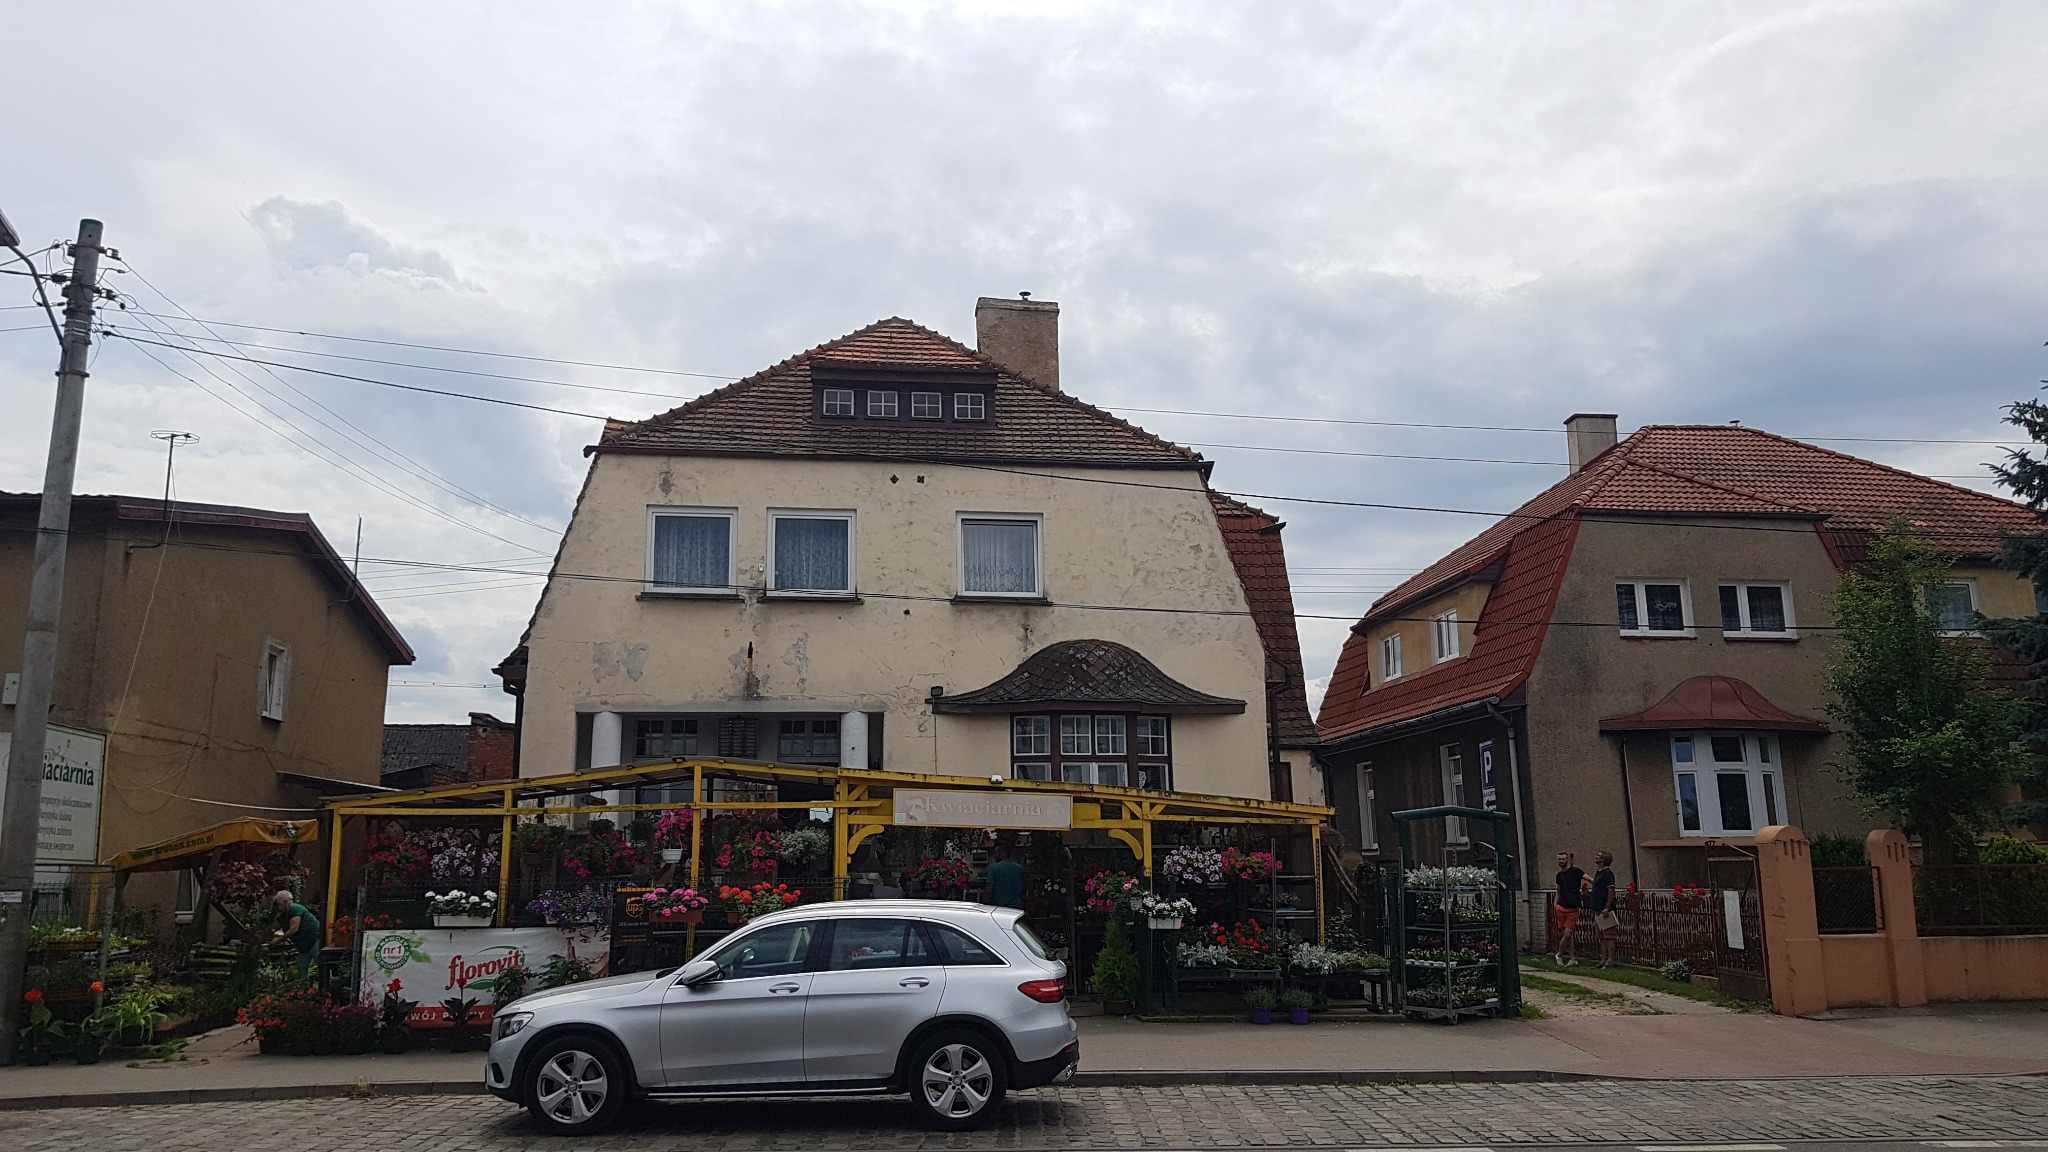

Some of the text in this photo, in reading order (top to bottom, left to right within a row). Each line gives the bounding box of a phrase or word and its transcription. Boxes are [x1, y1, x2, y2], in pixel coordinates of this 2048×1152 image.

[42, 754, 94, 786] iaciarnia
[1484, 751, 1492, 783] P
[925, 797, 1042, 816] Kwiaciarnia
[445, 949, 521, 990] florovit
[405, 1010, 436, 1021] WÓJ
